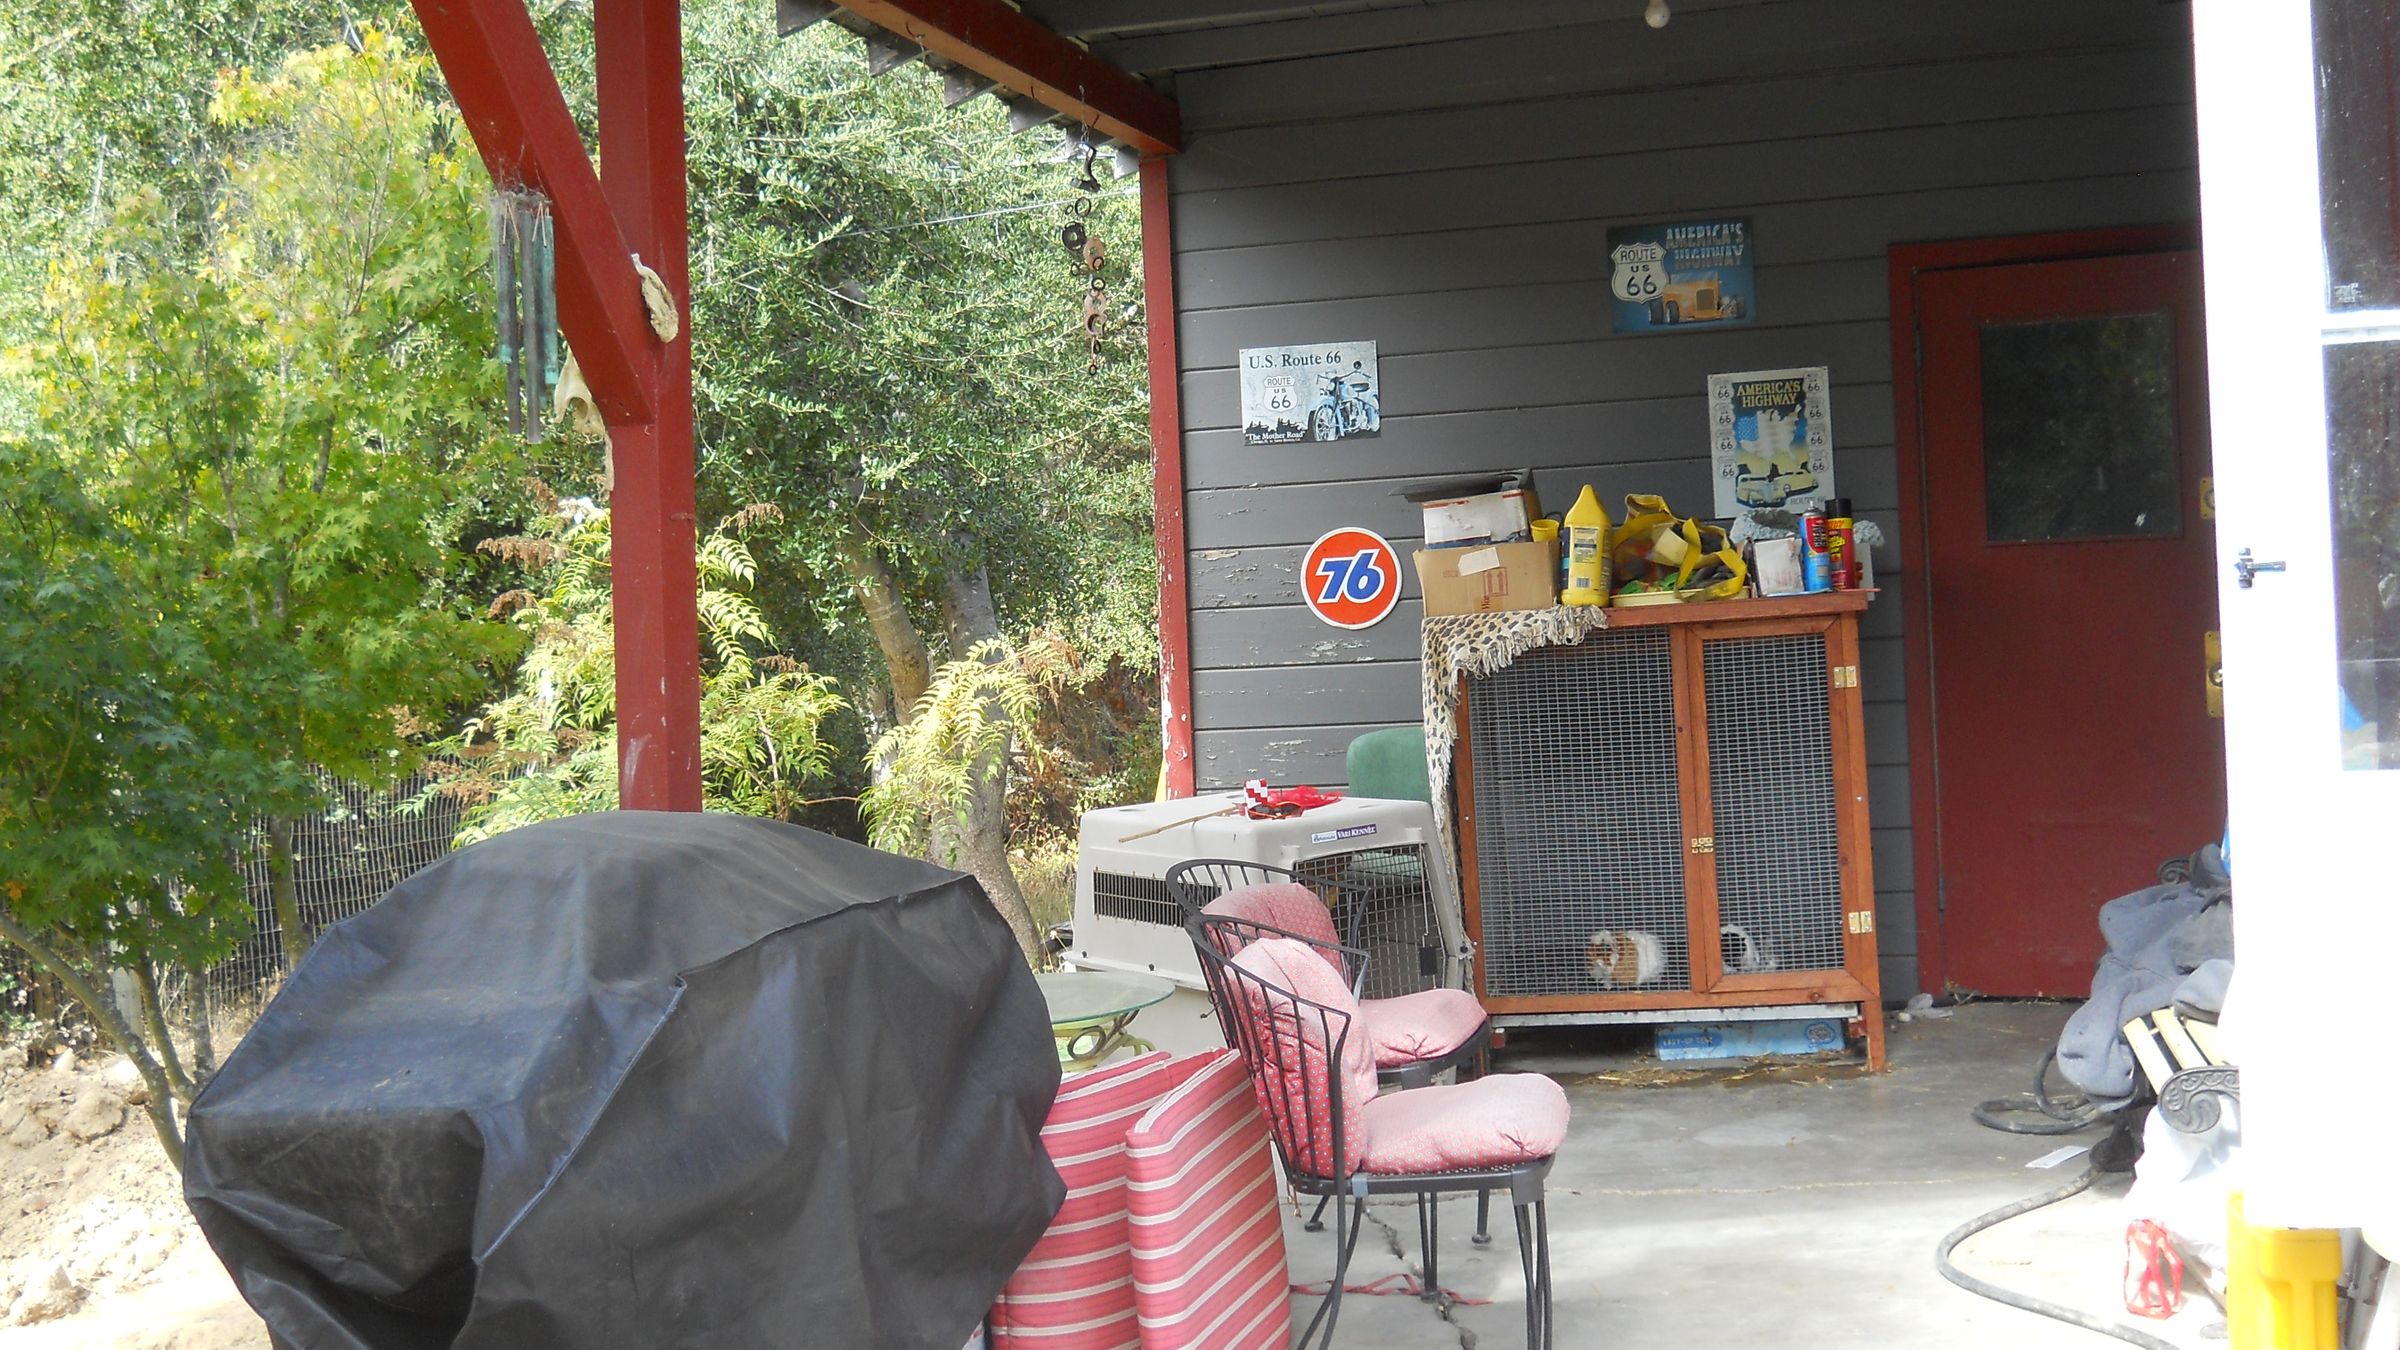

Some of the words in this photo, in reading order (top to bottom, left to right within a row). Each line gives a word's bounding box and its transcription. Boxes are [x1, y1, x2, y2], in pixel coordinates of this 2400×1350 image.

[1620, 248, 1657, 261] ROUTE
[1626, 274, 1657, 296] 66
[1249, 355, 1277, 369] U.S.
[1282, 353, 1322, 367] Route
[1326, 351, 1342, 364] 66
[1267, 377, 1291, 386] ROUTE
[1737, 380, 1801, 397] AMERICA'S
[1271, 395, 1291, 409] 66
[1742, 393, 1797, 408] HIGHWAY
[1261, 432, 1286, 440] Mother
[1316, 549, 1384, 603] 76
